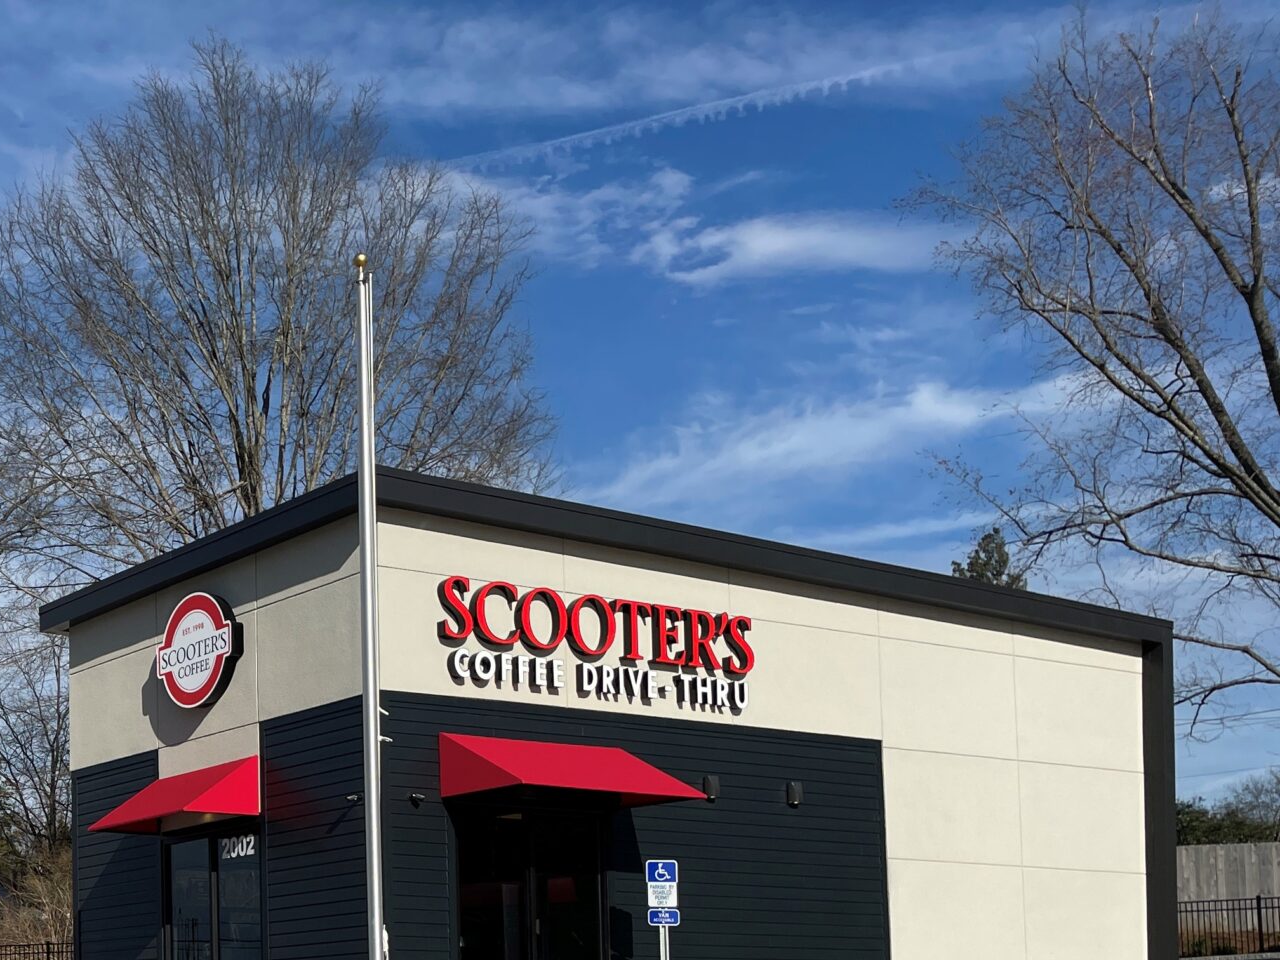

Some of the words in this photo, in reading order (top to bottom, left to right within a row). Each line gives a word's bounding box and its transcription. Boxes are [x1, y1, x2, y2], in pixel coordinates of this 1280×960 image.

[437, 575, 755, 673] SCOOTER'S
[161, 631, 227, 670] SCOOTER'S
[178, 658, 210, 679] COFFEE
[453, 648, 564, 689] COFFEE
[582, 663, 749, 709] DRIVE-THRU
[221, 834, 255, 859] 2002
